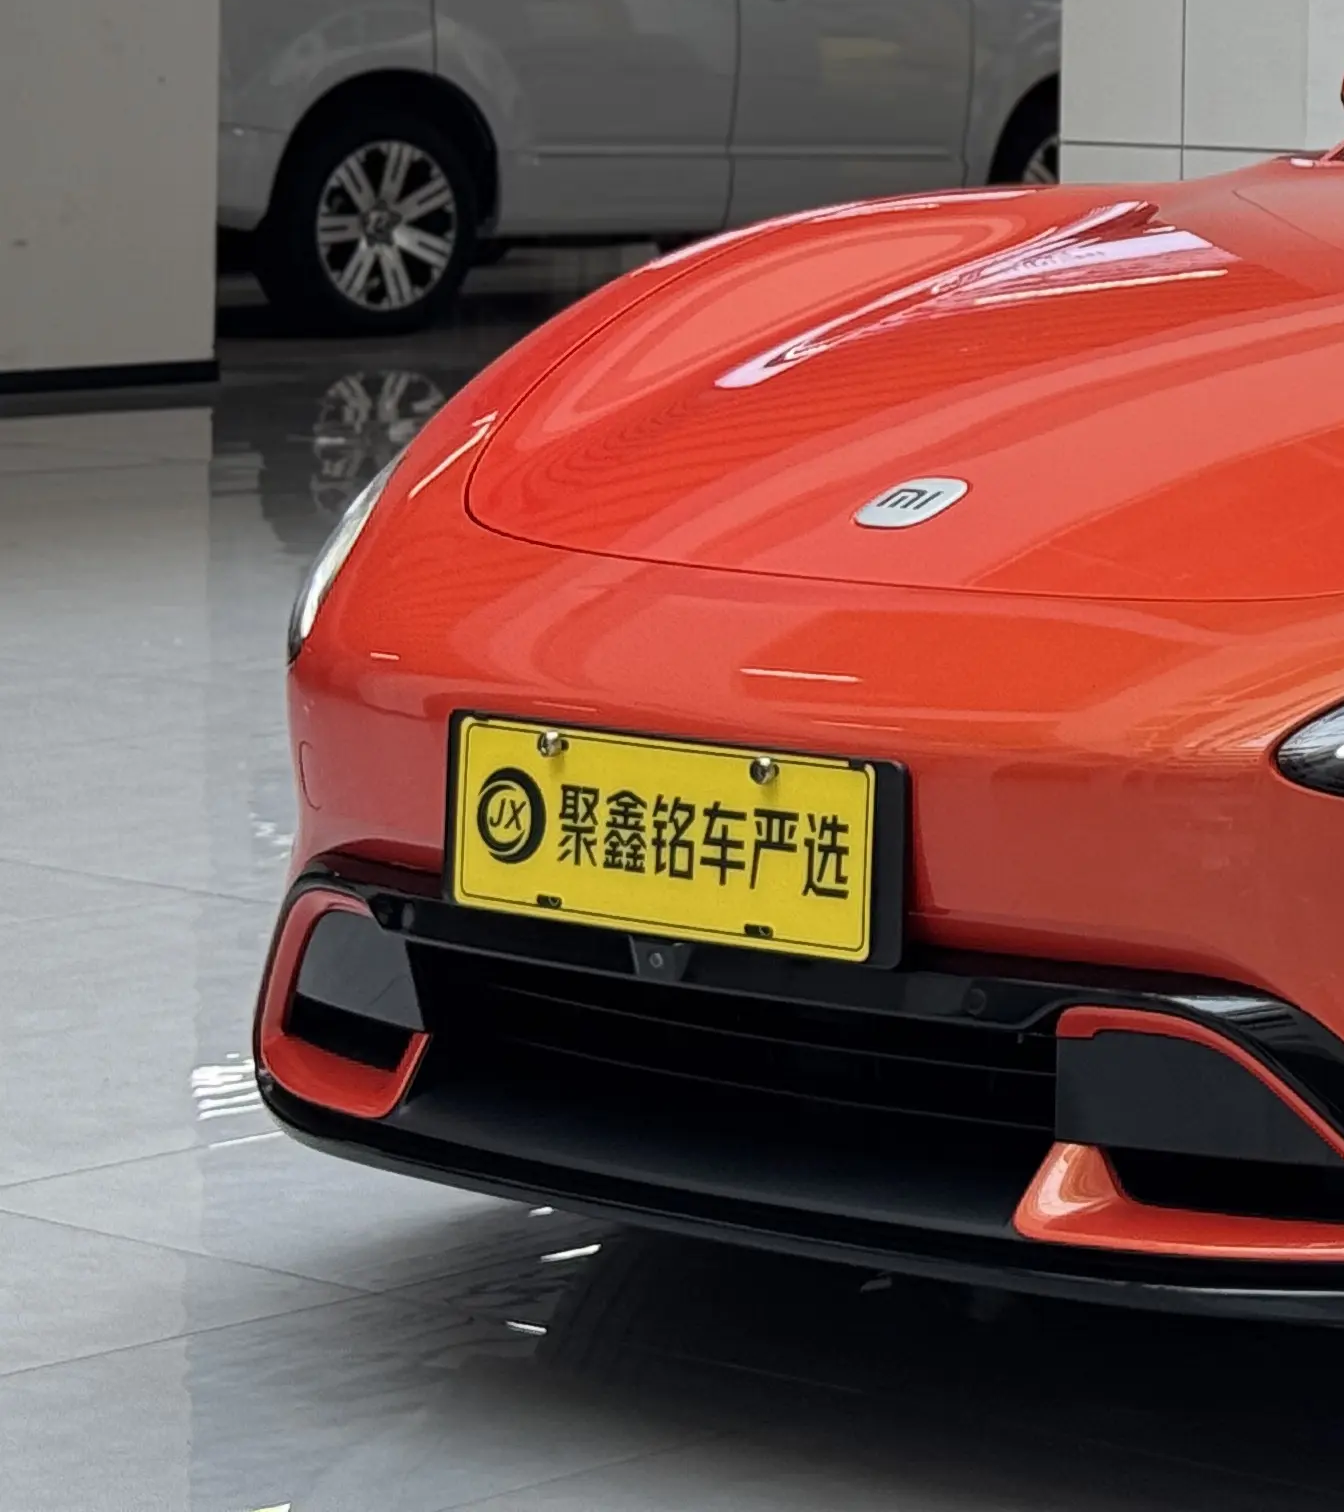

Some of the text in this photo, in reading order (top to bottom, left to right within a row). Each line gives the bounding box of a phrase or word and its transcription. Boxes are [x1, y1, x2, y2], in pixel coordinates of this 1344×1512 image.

[490, 798, 527, 830] JX
[557, 783, 850, 899] 聚鑫铭车严选
